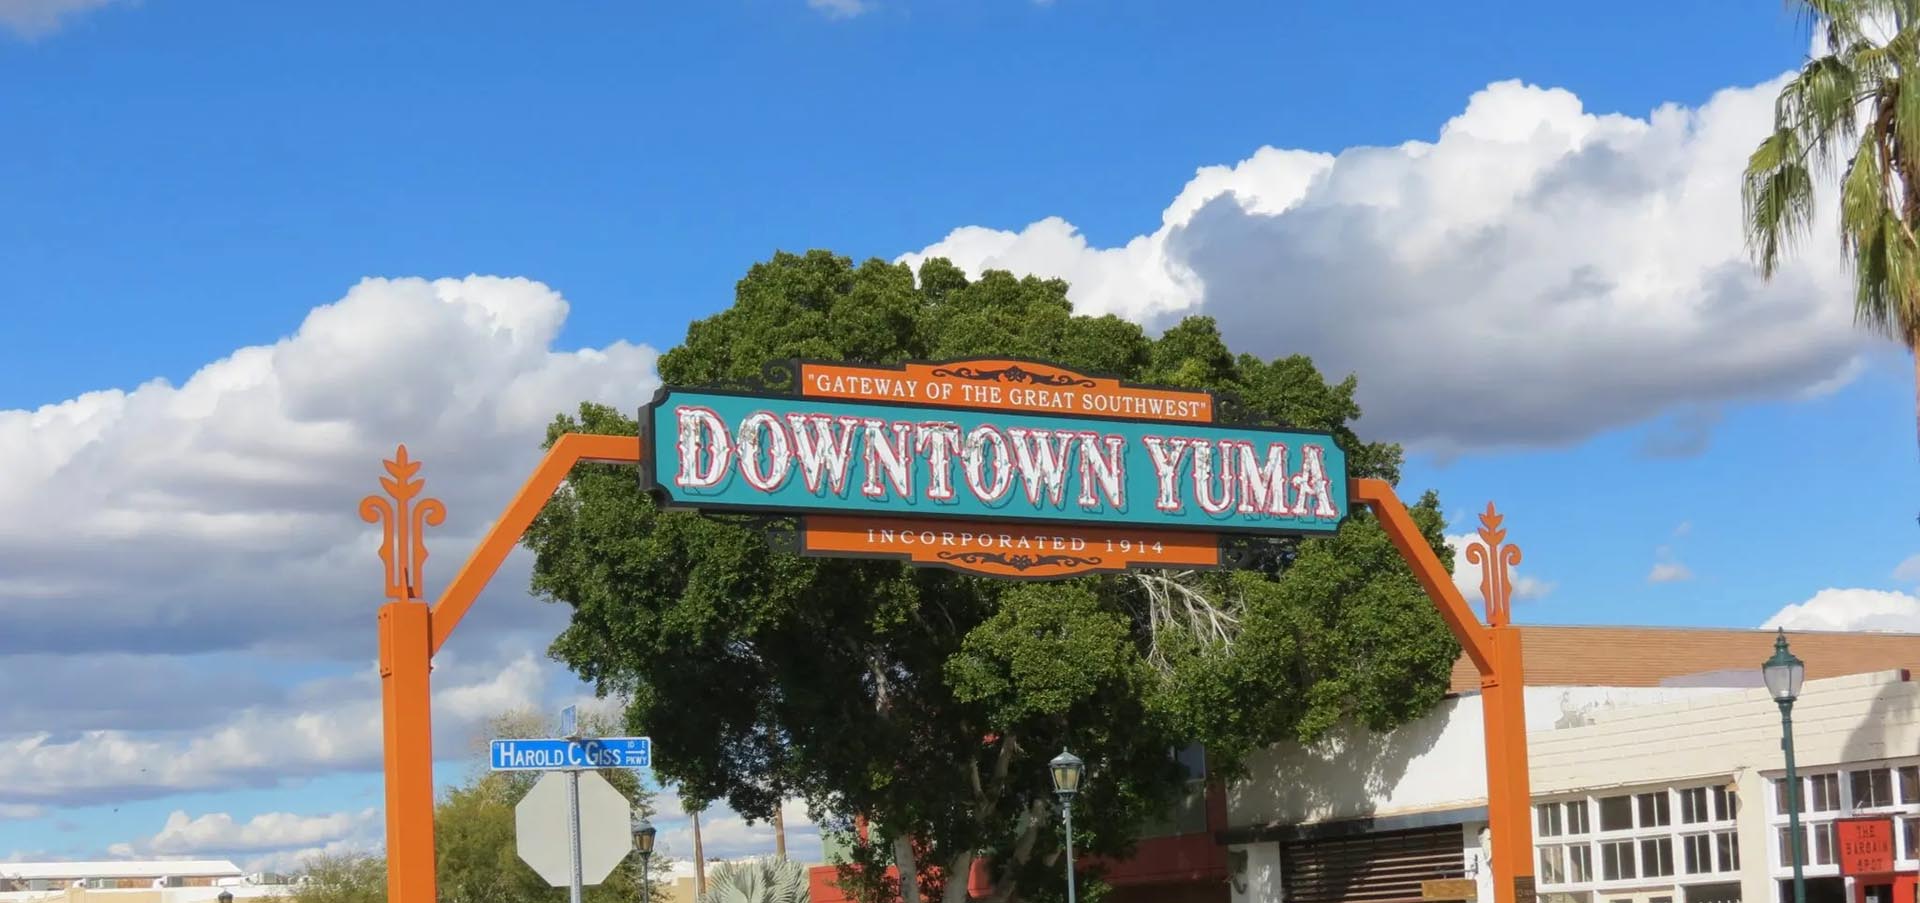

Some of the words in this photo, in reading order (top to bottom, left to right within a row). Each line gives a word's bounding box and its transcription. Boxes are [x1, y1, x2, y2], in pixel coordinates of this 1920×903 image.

[808, 373, 918, 398] "GATEWAY
[926, 382, 954, 400] OF
[962, 384, 1002, 404] THE
[1009, 388, 1075, 410] GREAT
[1082, 394, 1207, 418] SOUTHWEST"
[675, 405, 1125, 508] DOWNTOWN
[1142, 433, 1339, 519] YUMA
[867, 528, 1087, 552] INCORPORATED
[1105, 539, 1164, 555] 1914
[567, 742, 582, 766] C
[625, 755, 648, 765] PKWY
[1856, 824, 1877, 838] THE
[1846, 840, 1889, 856] BARGAIN
